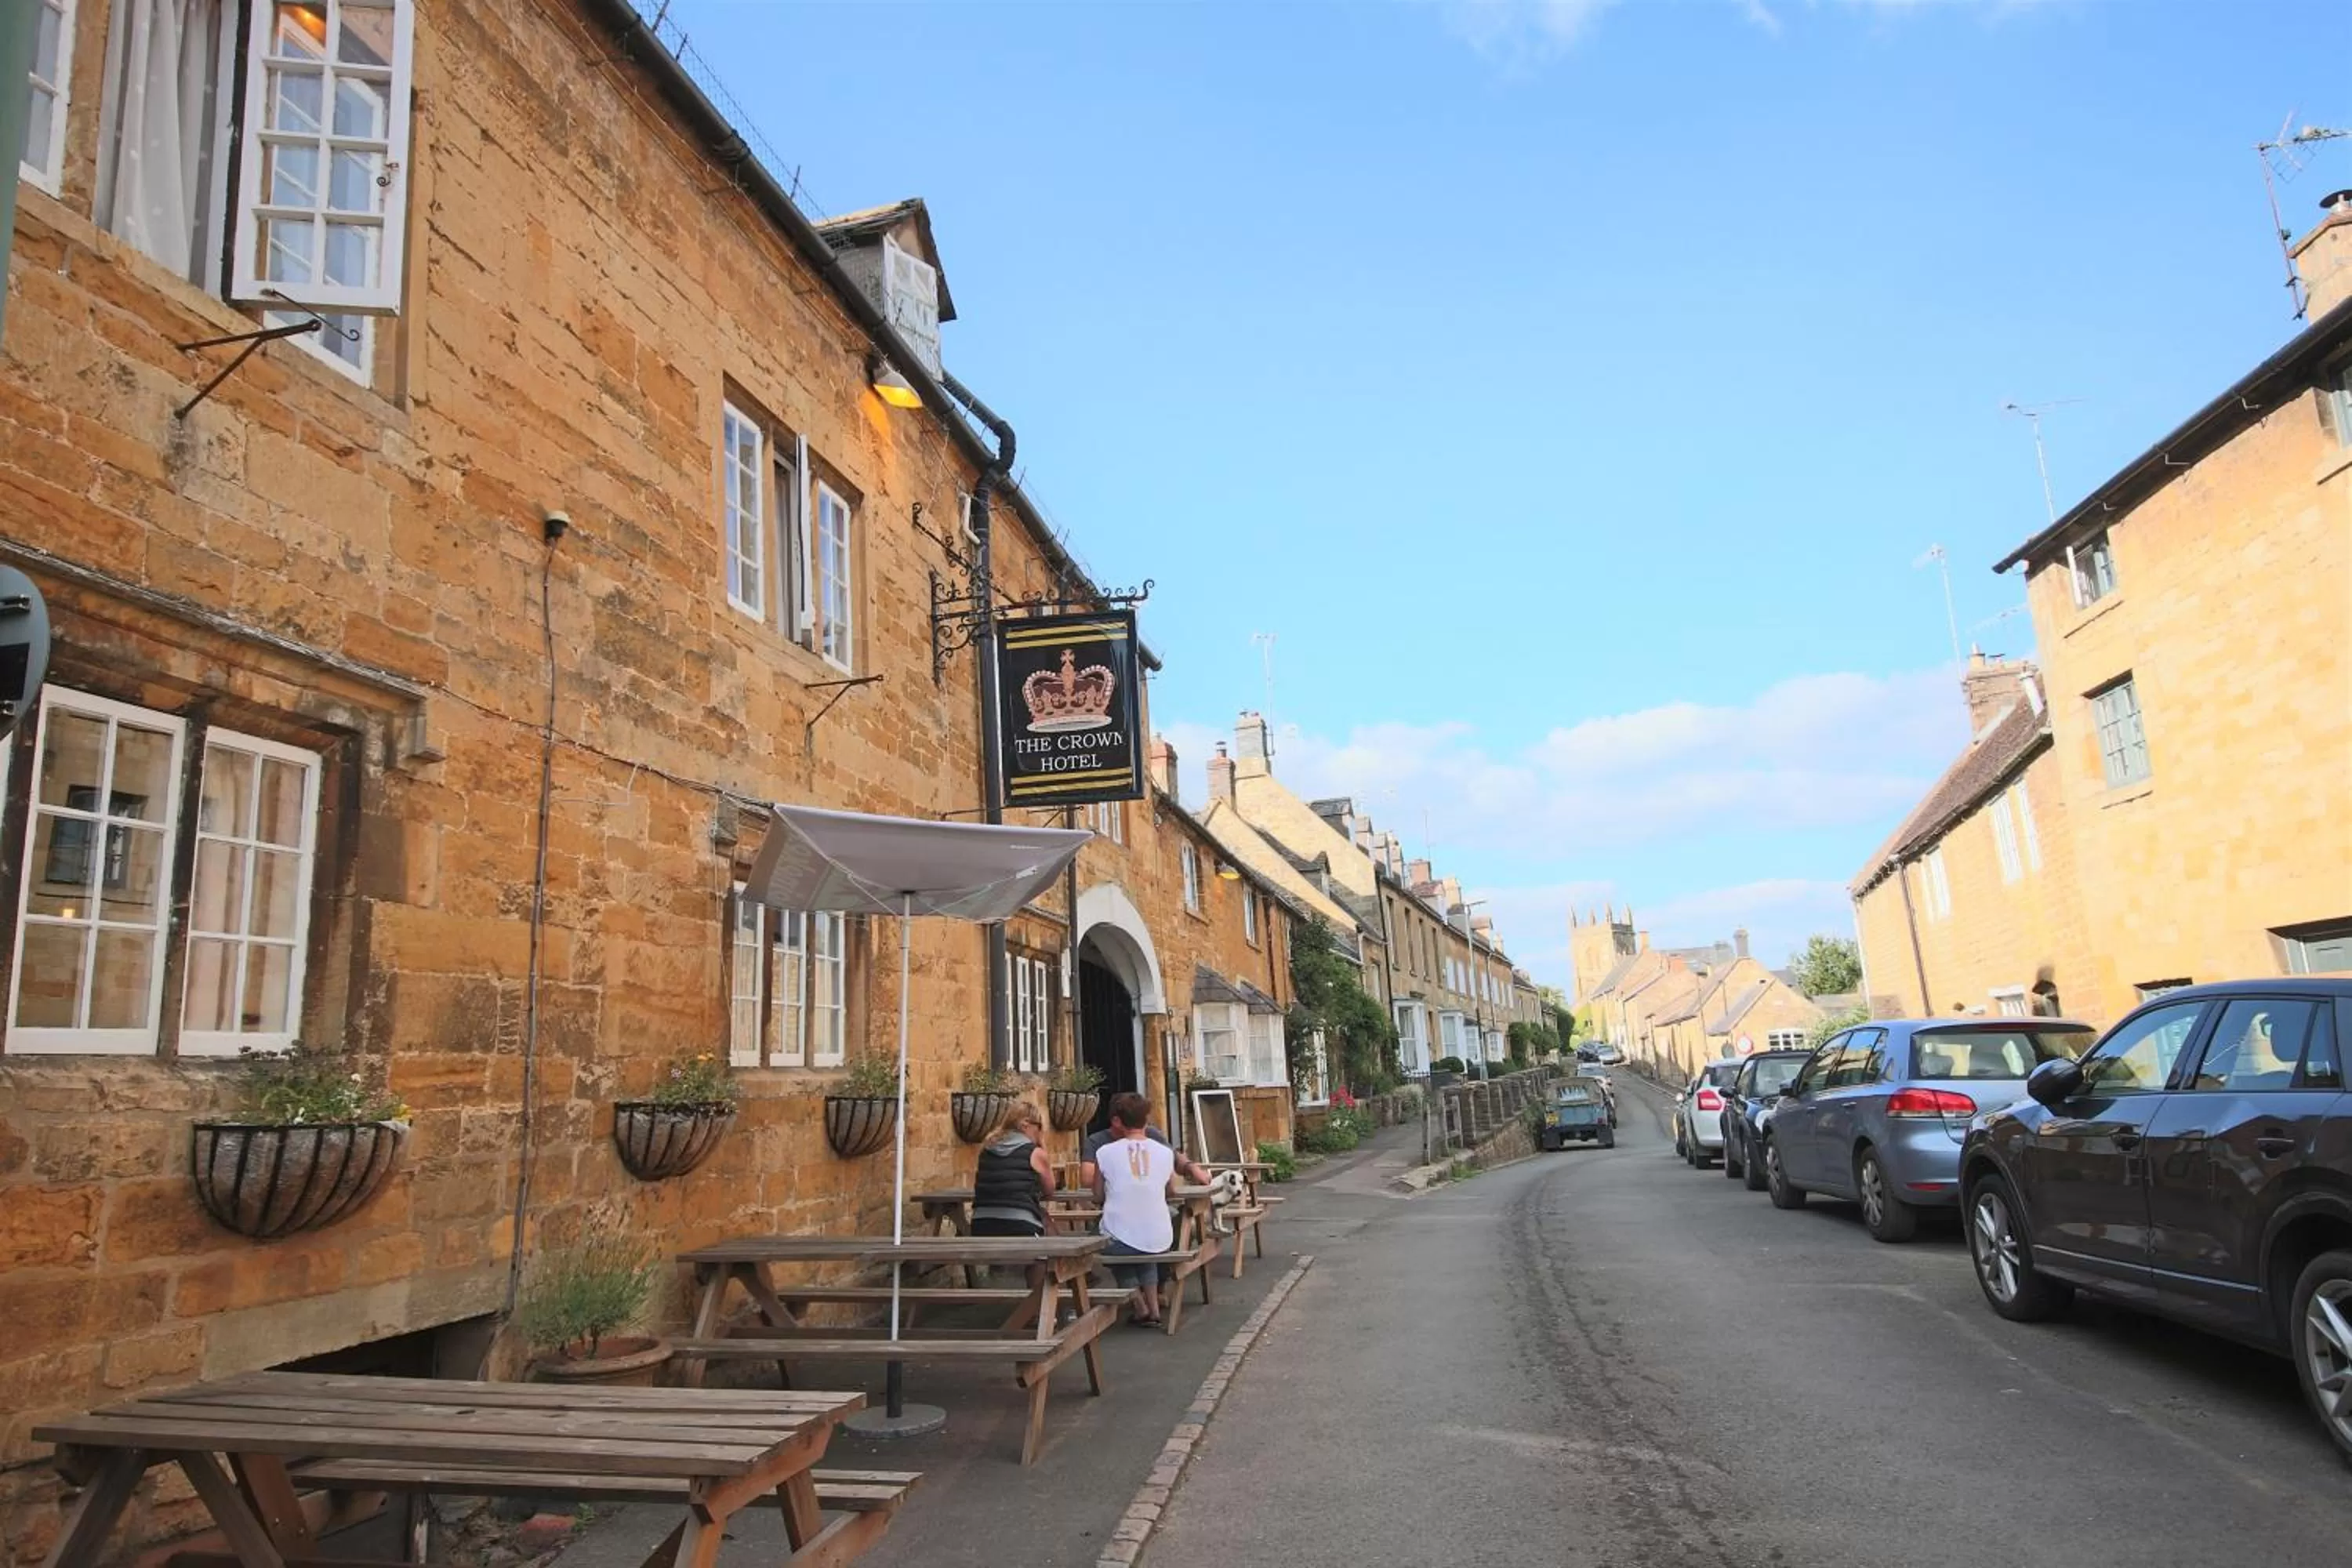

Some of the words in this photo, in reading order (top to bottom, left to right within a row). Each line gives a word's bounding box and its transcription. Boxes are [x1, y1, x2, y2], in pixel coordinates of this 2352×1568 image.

[1014, 737, 1052, 753] THE
[1058, 731, 1123, 750] CROWN
[1040, 753, 1102, 772] HOTEL
